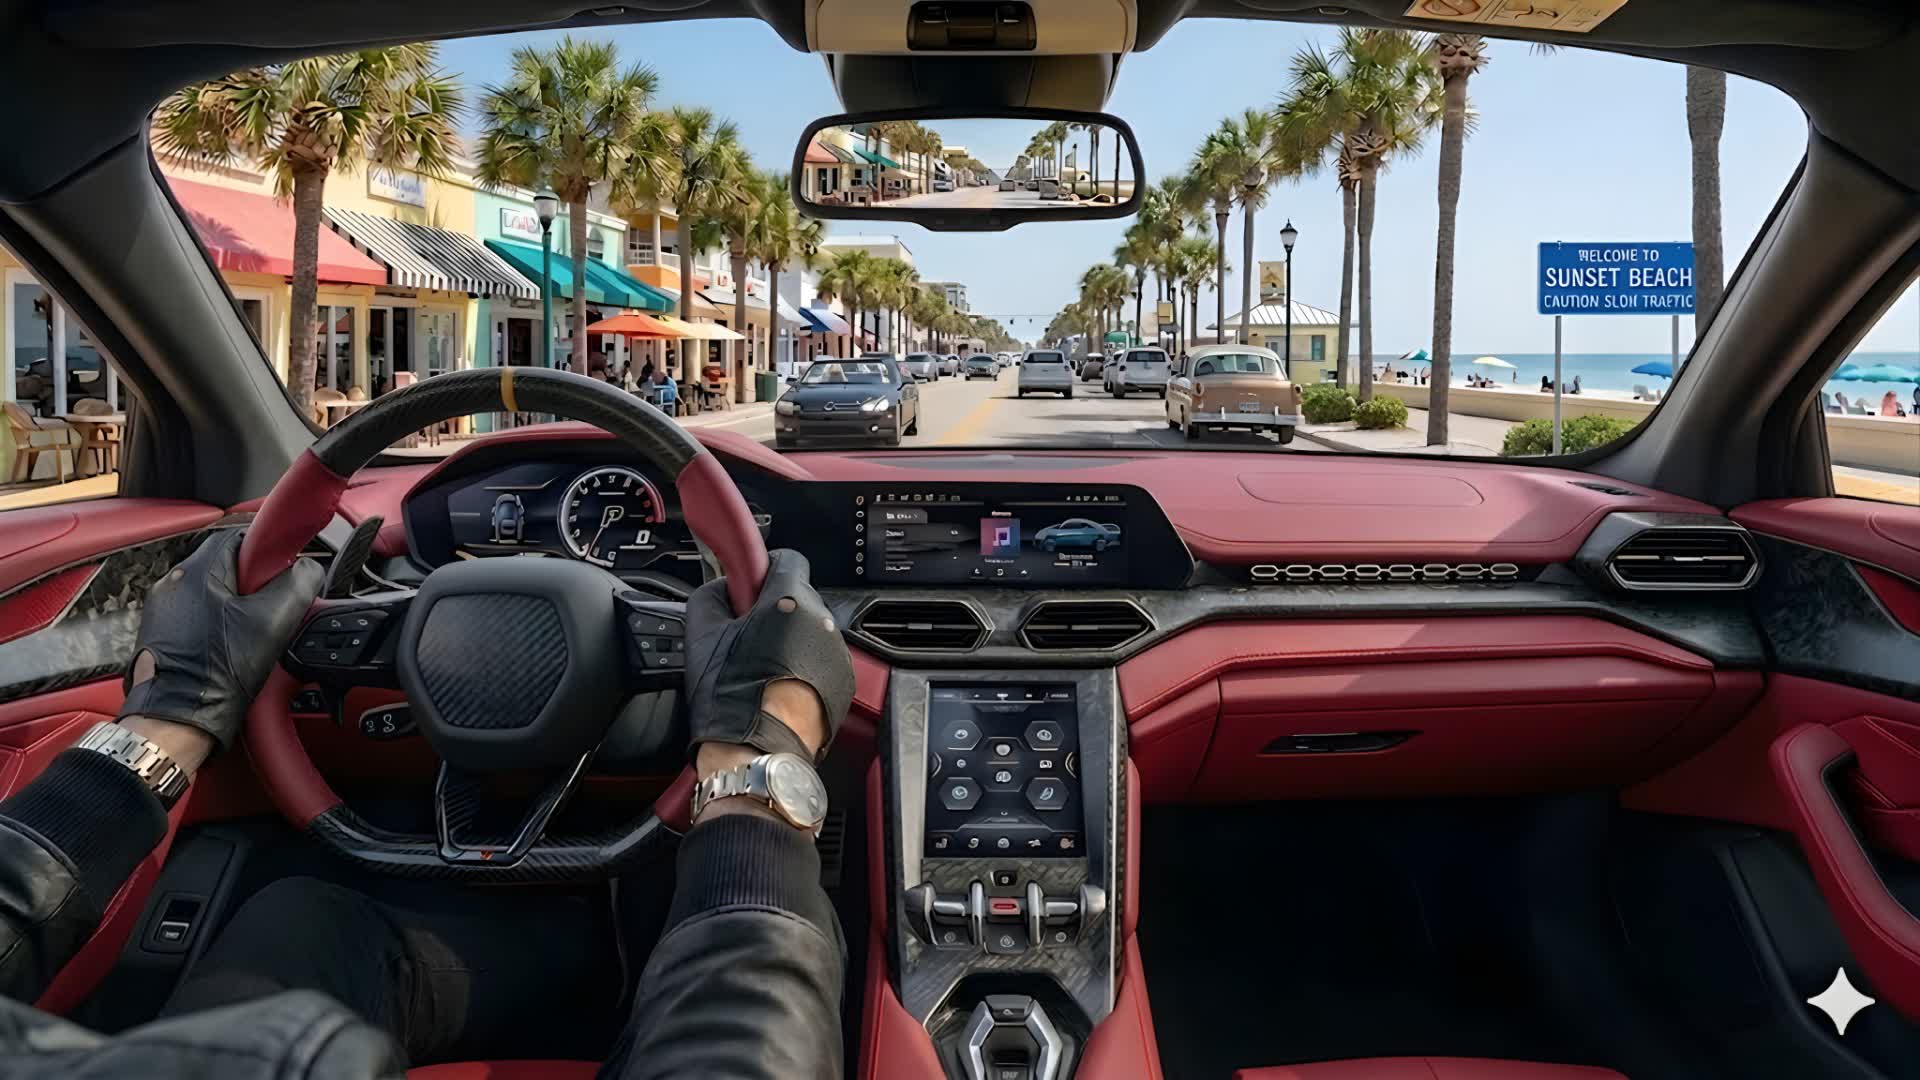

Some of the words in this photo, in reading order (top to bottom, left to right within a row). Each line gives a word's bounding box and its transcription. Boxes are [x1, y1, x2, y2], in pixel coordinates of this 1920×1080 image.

[1643, 249, 1659, 262] TO
[1545, 268, 1620, 287] SUNSET
[1629, 268, 1692, 287] BEACH
[1544, 295, 1600, 308] CAUTION
